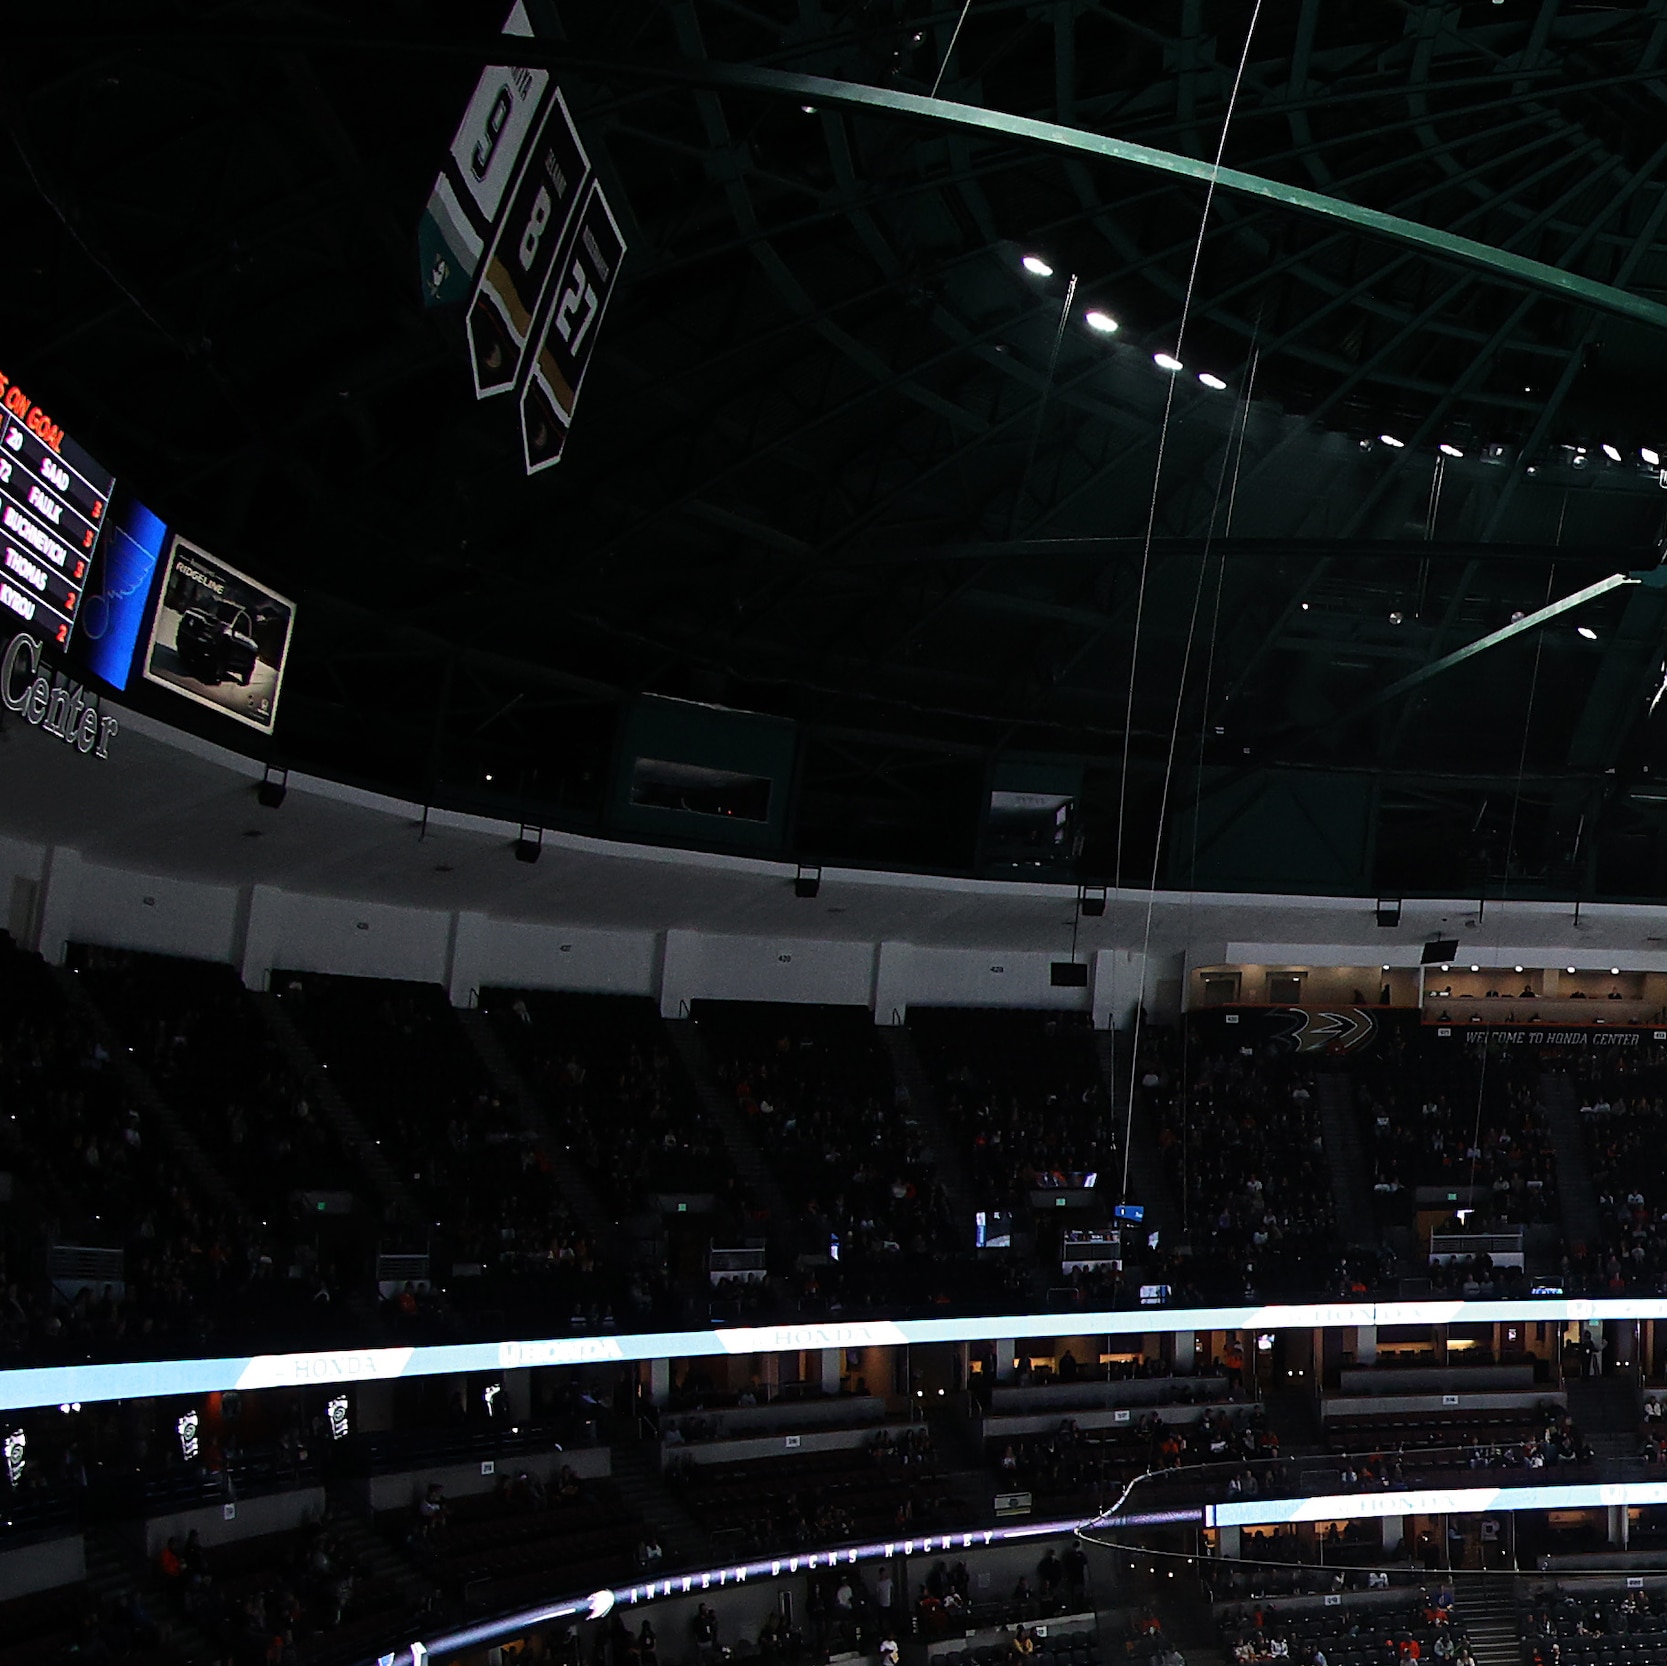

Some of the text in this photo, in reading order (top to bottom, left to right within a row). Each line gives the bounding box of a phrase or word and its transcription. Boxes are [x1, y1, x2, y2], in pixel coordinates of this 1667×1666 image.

[518, 185, 552, 272] 8
[4, 386, 65, 454] ON GOAL
[40, 457, 70, 492] SAAD
[28, 485, 63, 525] FAULK
[3, 506, 67, 567] BUCHNEVICH
[5, 547, 48, 591] THOMAS
[176, 561, 224, 593] RIDGELINE
[56, 623, 68, 643] 2
[1, 632, 118, 760] Center
[1466, 1031, 1640, 1046] WELCOME TO HONDA CENTER
[775, 1328, 873, 1345] HONDA
[294, 1357, 377, 1377] HONDA
[630, 1532, 993, 1603] ANAHEIM DUCKS HOCKEY
